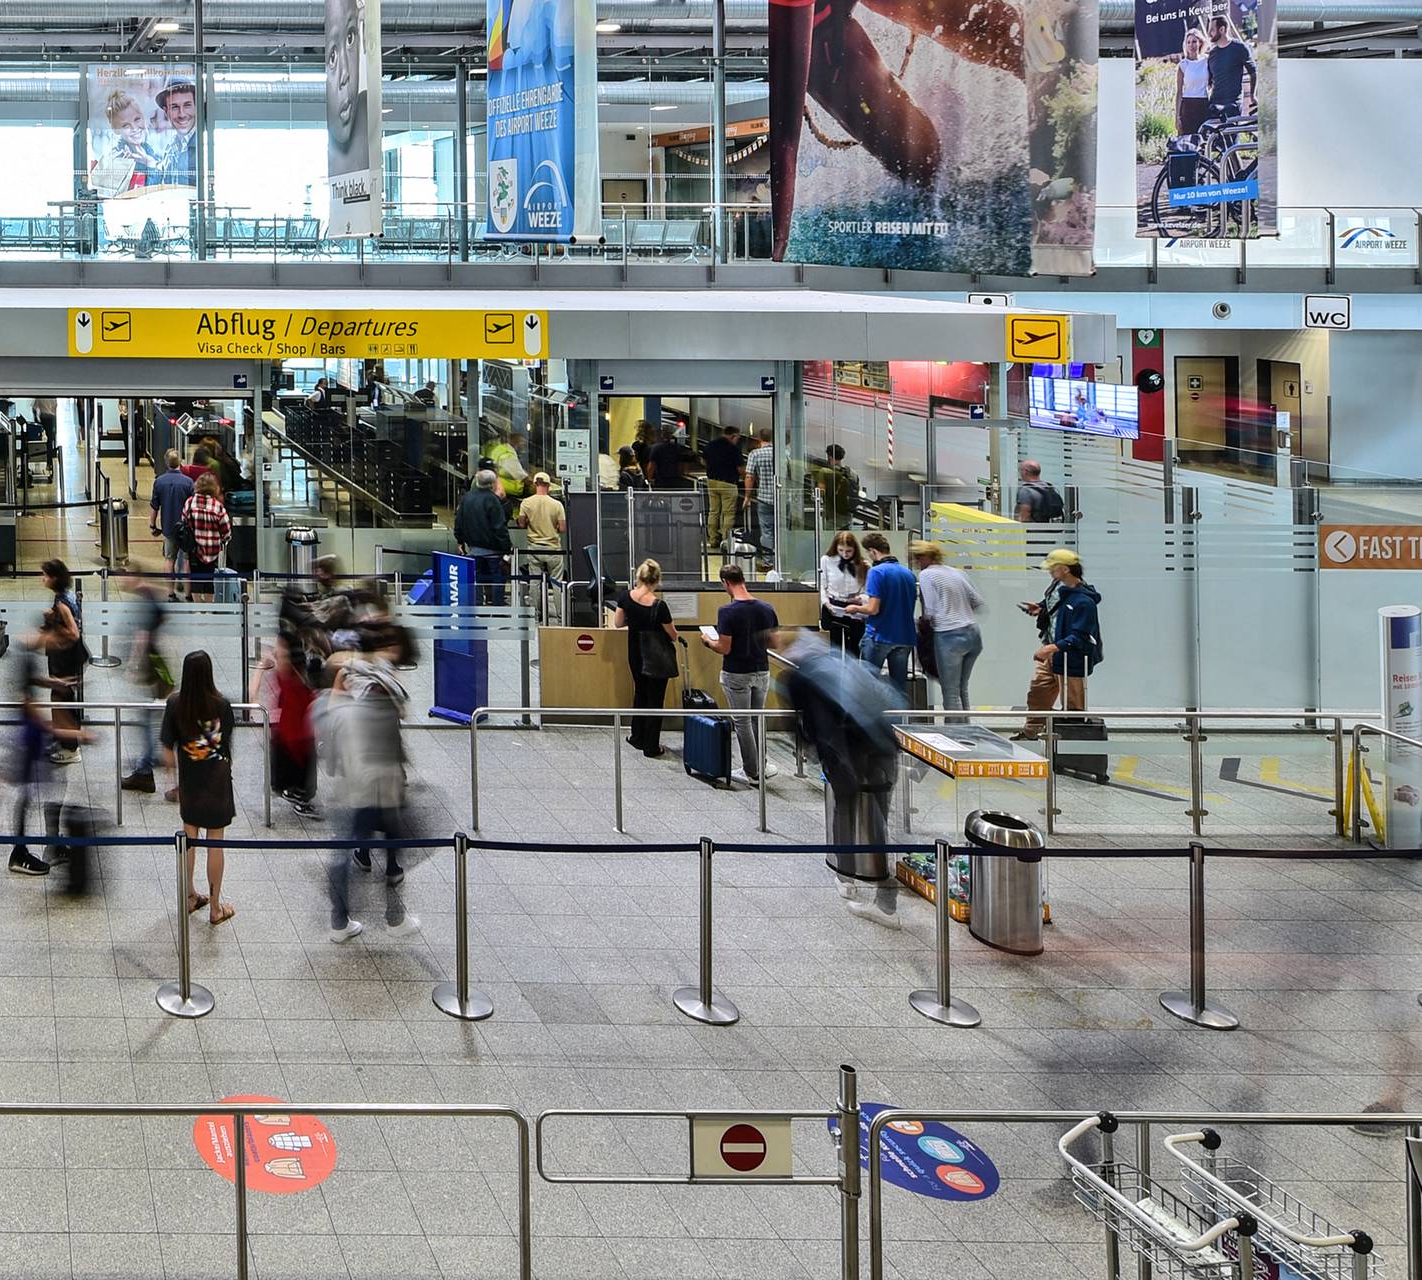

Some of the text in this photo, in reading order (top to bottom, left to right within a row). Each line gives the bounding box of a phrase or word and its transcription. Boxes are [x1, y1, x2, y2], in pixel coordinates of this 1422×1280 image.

[1146, 2, 1229, 24] Bei uns in Kevelaer
[488, 82, 564, 117] OFFIZIELLE EHRENGARDE
[495, 109, 558, 139] DES AIRPORT WEEZE
[331, 180, 348, 200] Think
[1187, 191, 1195, 200] 10
[1196, 190, 1207, 198] km
[1208, 190, 1221, 198] von
[1222, 186, 1248, 196] Weeze!
[528, 202, 562, 211] AIRPORT
[529, 211, 562, 228] WEEZE
[828, 221, 873, 234] SPORTLER
[875, 221, 909, 234] REISEN
[911, 222, 932, 235] MIT
[1179, 240, 1231, 249] AIRPORT WEEZE
[1355, 240, 1407, 249] AIRPORT WEEZE
[196, 312, 276, 340] Abflug
[301, 316, 418, 341] Departures
[1309, 311, 1346, 326] WC
[197, 342, 223, 354] Visa
[227, 342, 263, 355] Check
[276, 343, 307, 356] Shop
[320, 343, 346, 355] Bars
[1359, 535, 1422, 560] FAST T
